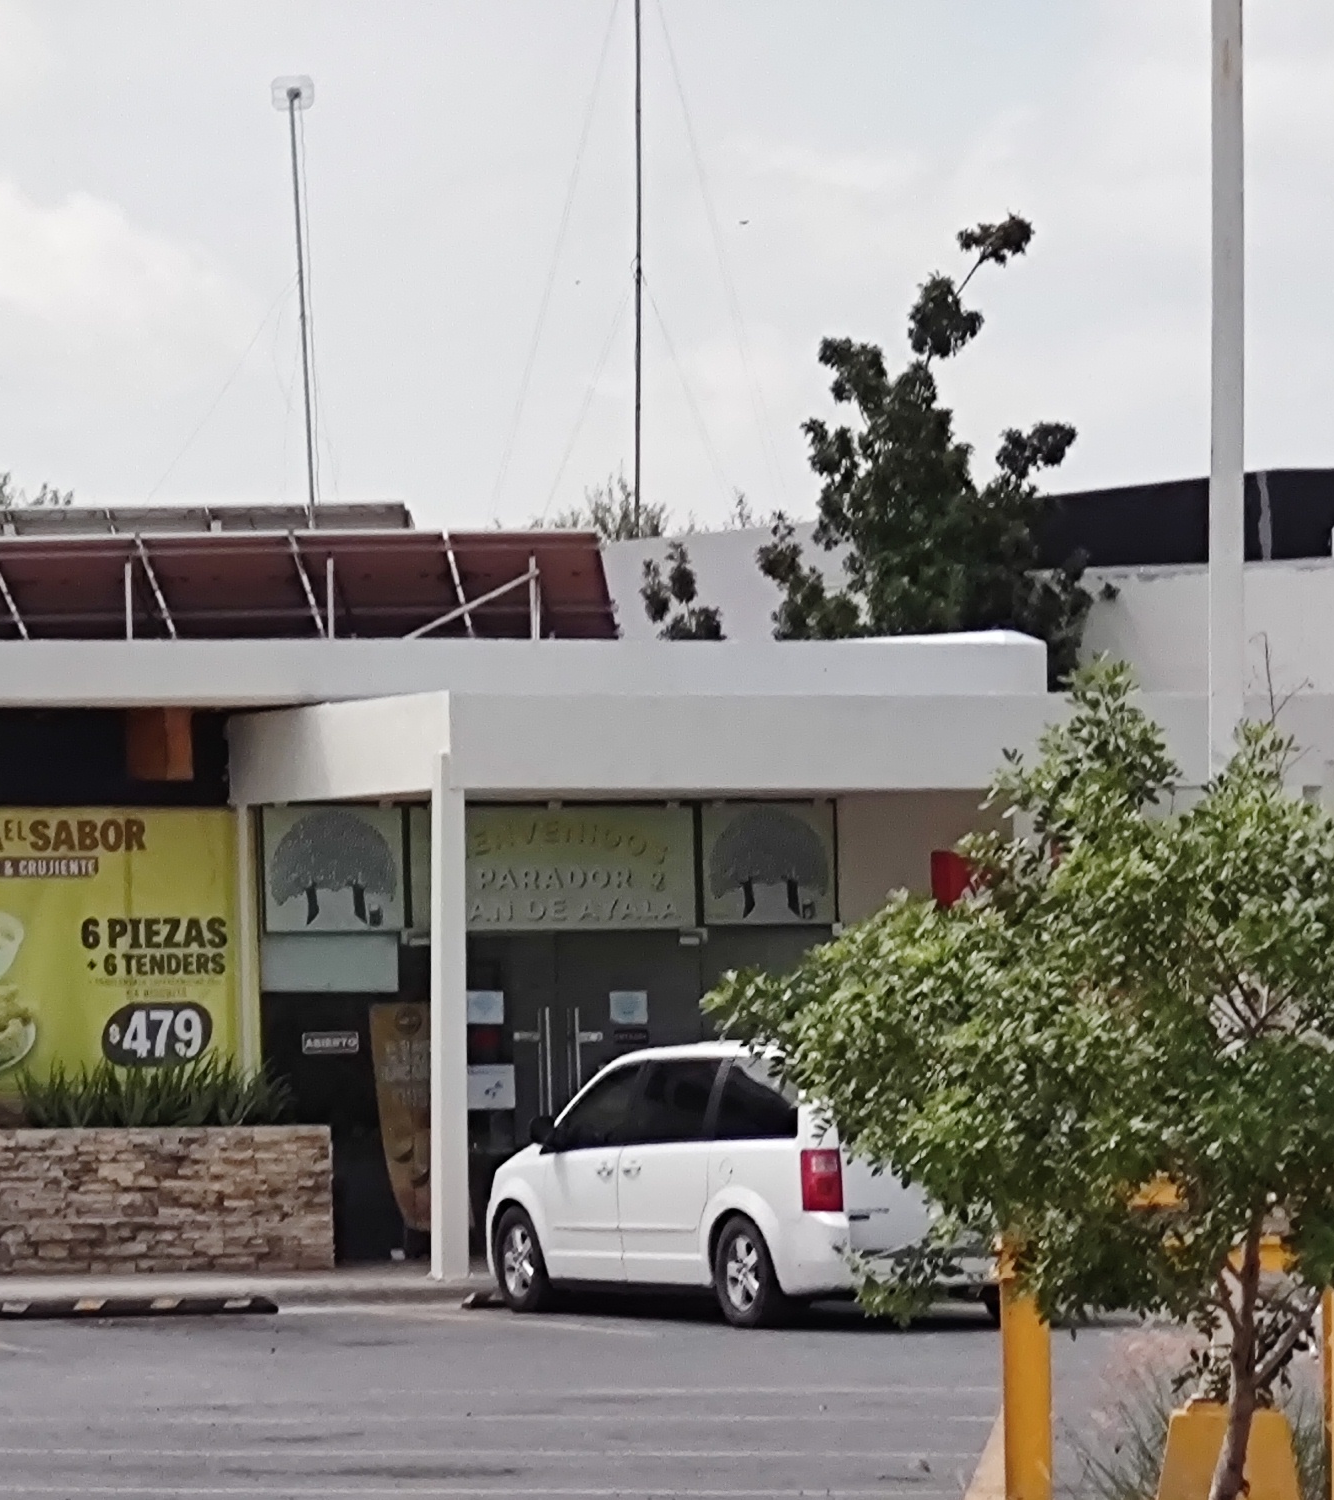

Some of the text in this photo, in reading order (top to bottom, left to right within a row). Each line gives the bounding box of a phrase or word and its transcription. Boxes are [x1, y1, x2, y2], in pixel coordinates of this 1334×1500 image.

[4, 819, 28, 842] EL
[29, 819, 148, 853] SABOR
[3, 860, 15, 877] &
[18, 859, 96, 878] CRUJIENTE
[478, 865, 634, 892] PARADOR
[525, 899, 569, 925] DE
[577, 897, 684, 925] AYALA
[80, 916, 228, 950] 6 PIEZAS
[103, 952, 118, 976] 6
[122, 952, 226, 976] TENDERS
[108, 1008, 204, 1058] $479
[303, 1037, 358, 1049] ABIERTO
